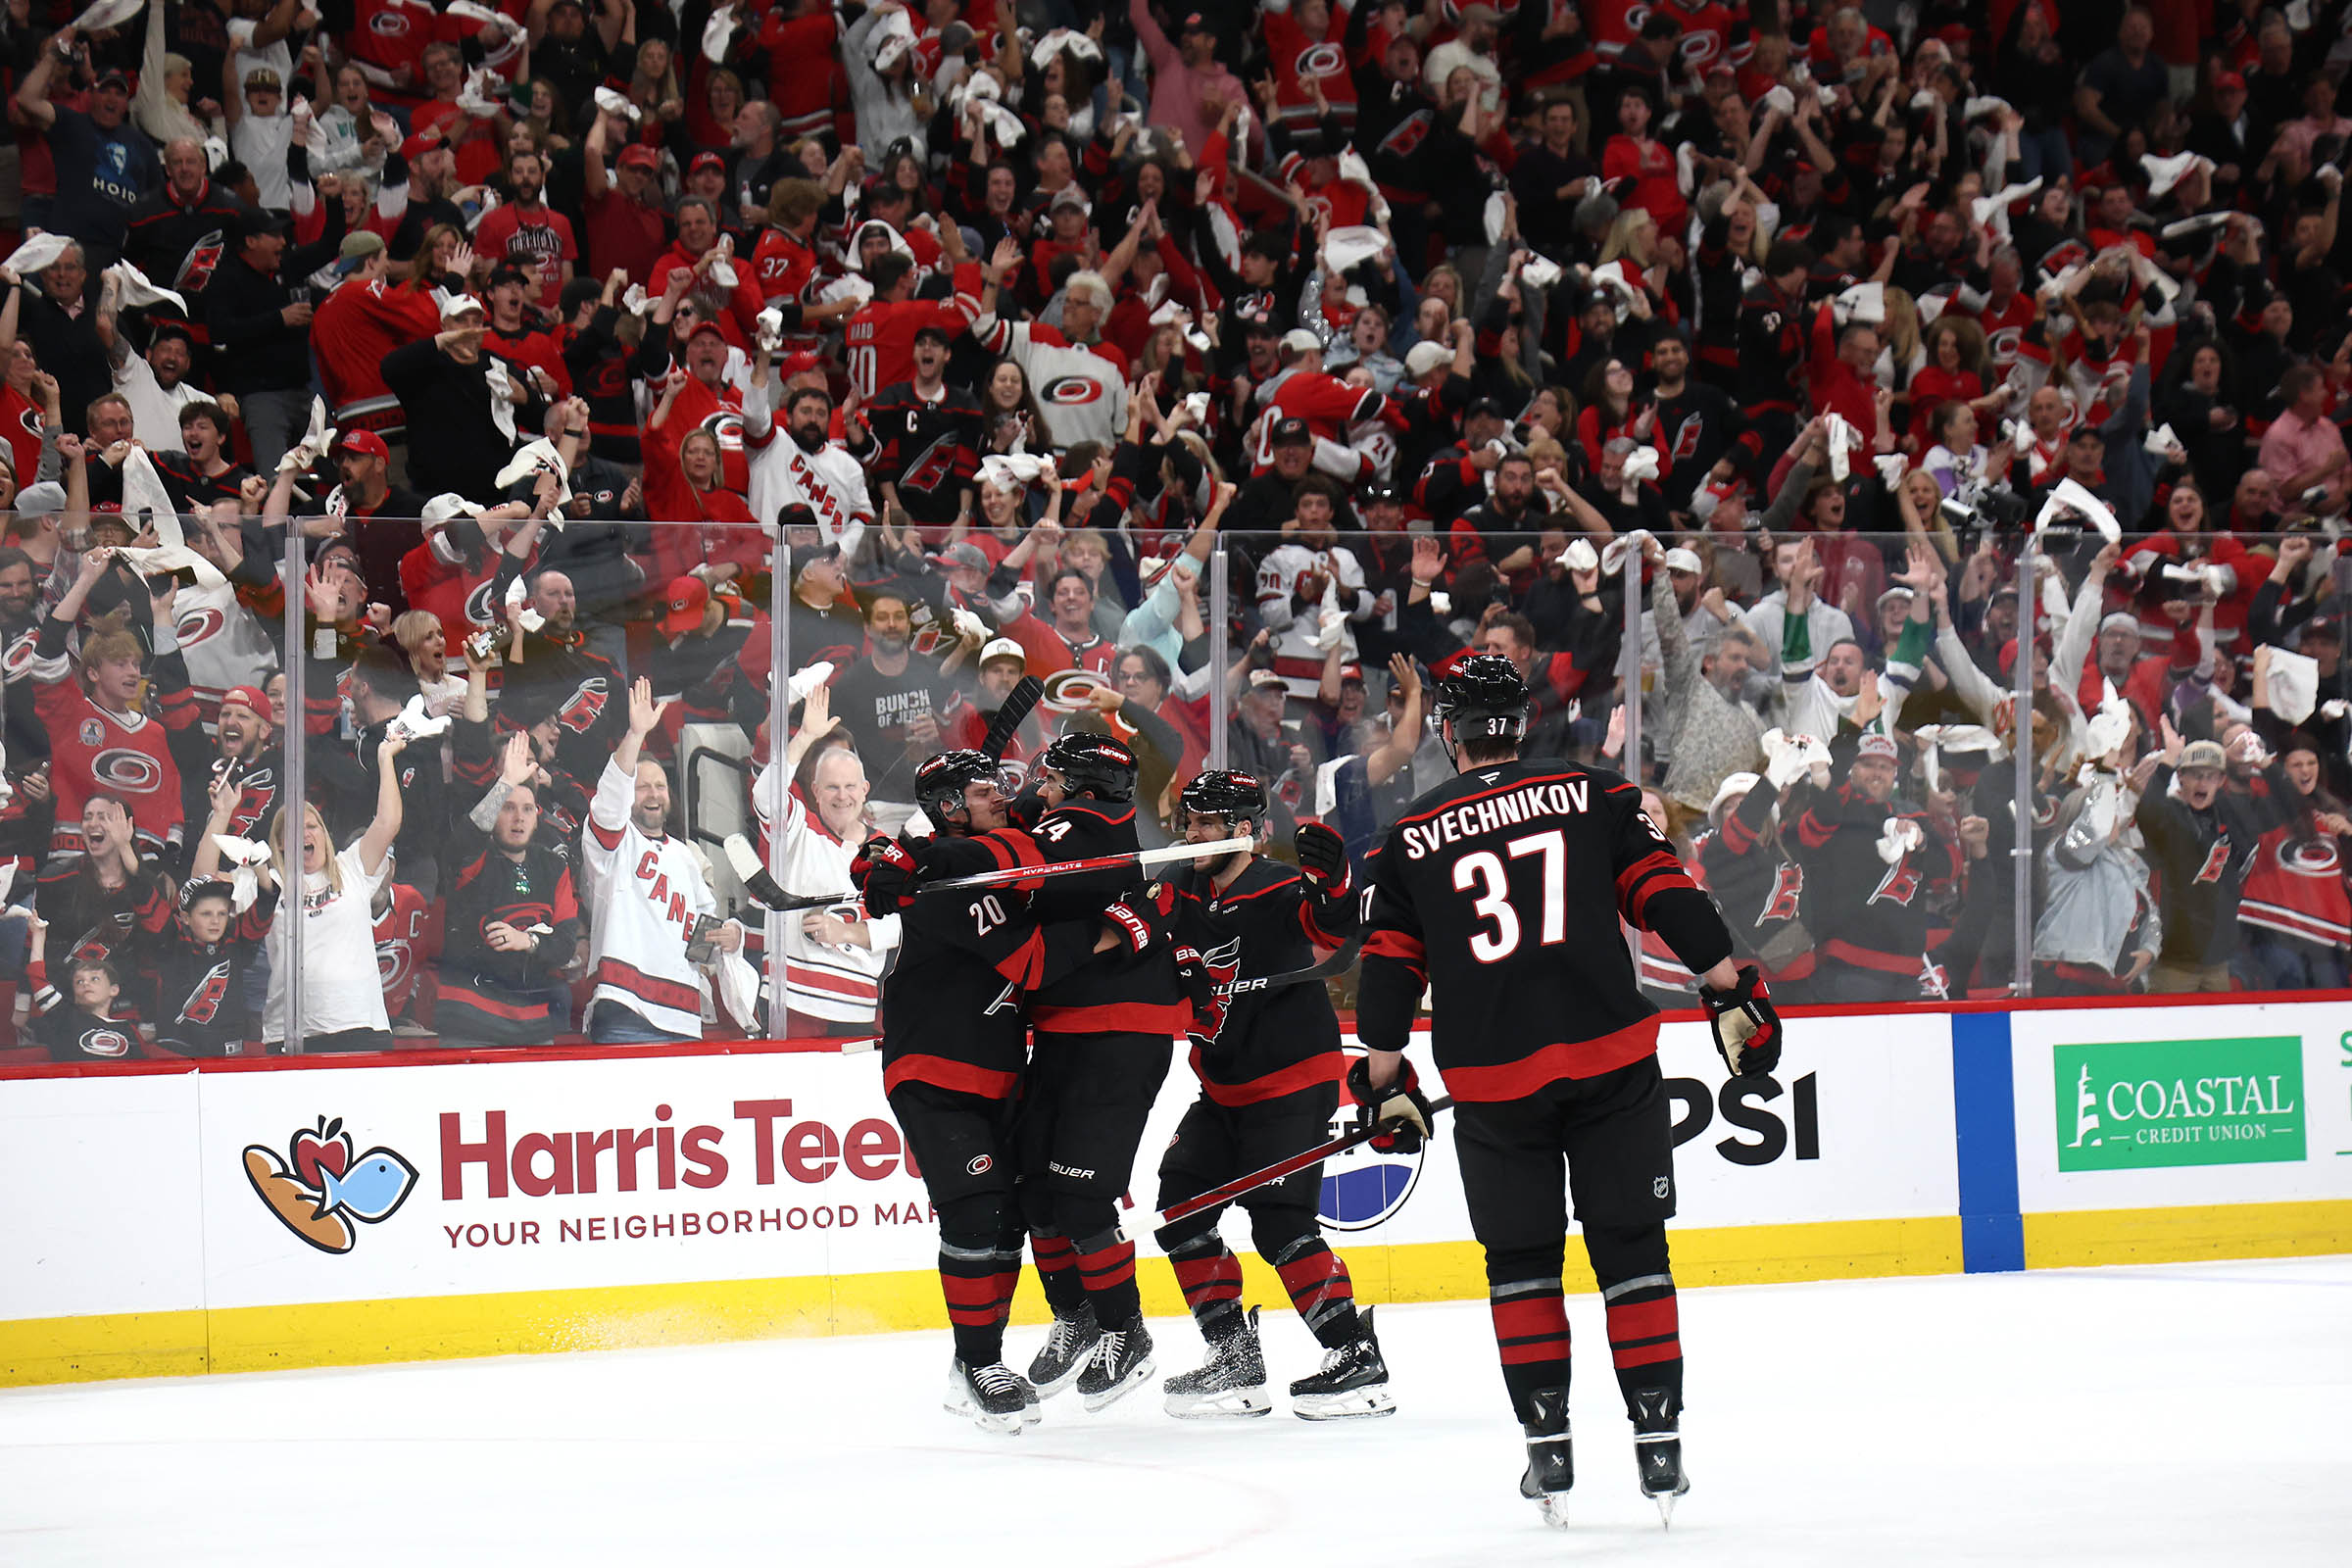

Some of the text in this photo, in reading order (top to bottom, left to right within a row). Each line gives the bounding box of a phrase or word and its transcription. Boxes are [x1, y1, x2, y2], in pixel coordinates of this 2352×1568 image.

[760, 257, 789, 278] 37
[906, 410, 918, 433] C
[875, 688, 931, 715] BUNCH
[877, 712, 893, 729] OF
[1487, 717, 1507, 736] 37
[1100, 745, 1129, 762] Lenovo
[1402, 780, 1590, 860] SVECHNIKOV
[1022, 860, 1083, 876] HYPERLITE
[635, 850, 696, 942] CANE
[1359, 884, 1377, 925] 7
[1450, 827, 1567, 964] 37
[409, 909, 422, 939] C
[968, 893, 1007, 937] 20
[1104, 902, 1149, 950] BAUER
[1211, 977, 1269, 997] UER
[2107, 1075, 2295, 1121] COASTAL
[1666, 1071, 1821, 1166] PSI
[2135, 1123, 2268, 1145] CREDIT UNION
[438, 1103, 729, 1201] Harris
[443, 1221, 541, 1250] YOUR
[560, 1203, 859, 1243] NEIGHBORHOOD
